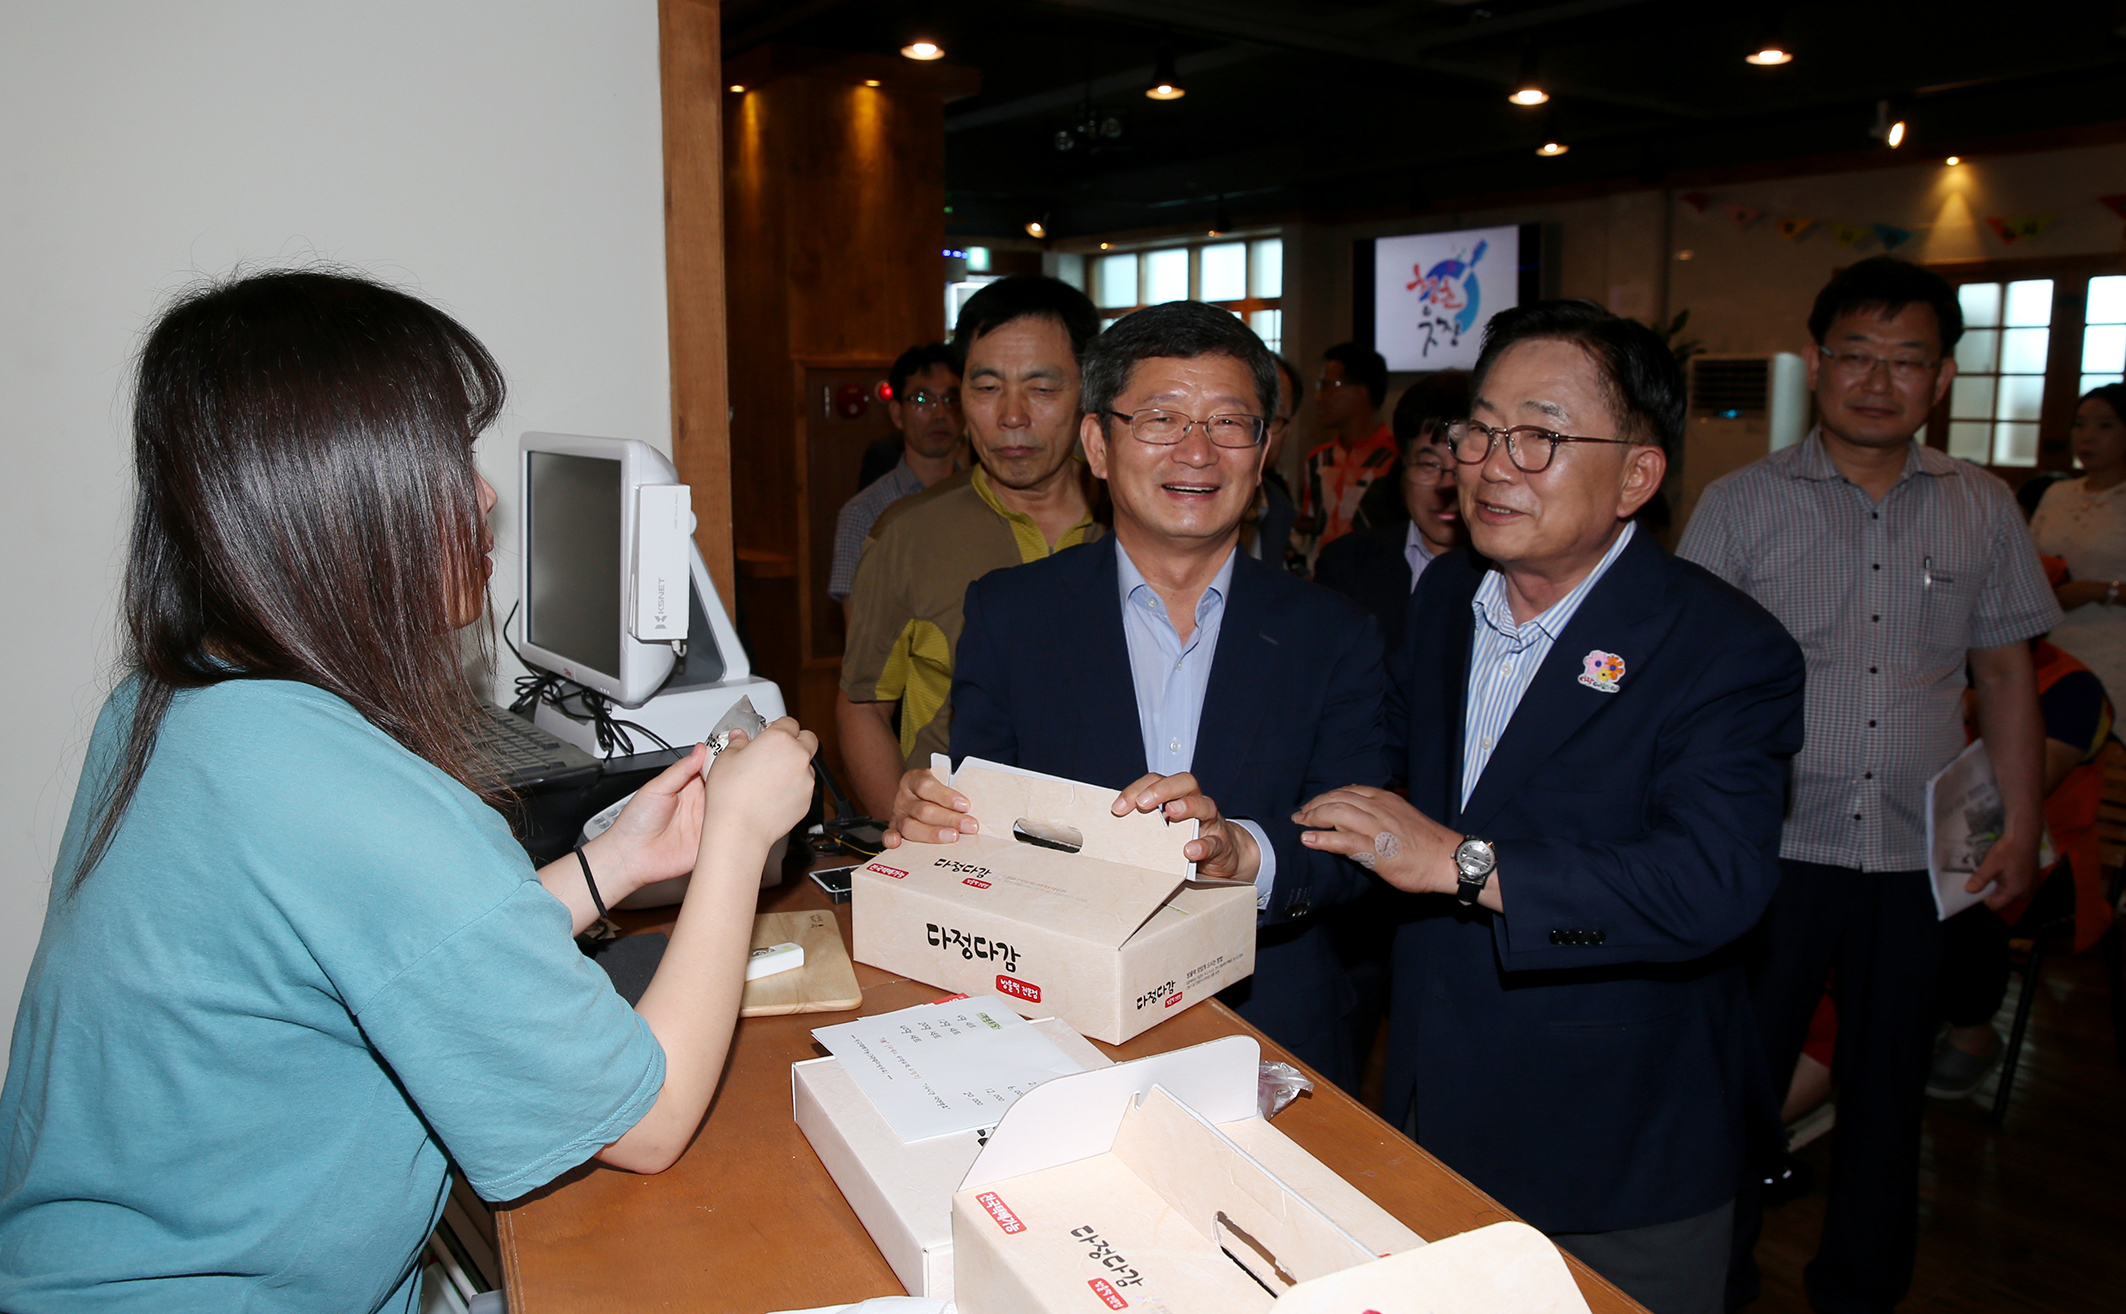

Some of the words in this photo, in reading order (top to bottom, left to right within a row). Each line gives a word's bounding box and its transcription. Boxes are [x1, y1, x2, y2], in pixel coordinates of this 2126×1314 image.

[657, 577, 666, 615] KSNET
[933, 858, 992, 879] 다정다감
[926, 923, 1021, 973] 다정다감
[1000, 978, 1020, 994] 방울떡
[1021, 983, 1039, 1000] 전문점
[1136, 980, 1176, 1010] 다정다감
[962, 1091, 984, 1106] 20,000
[979, 1193, 1022, 1233] 전국택배가능
[1070, 1225, 1144, 1288] 다정다감
